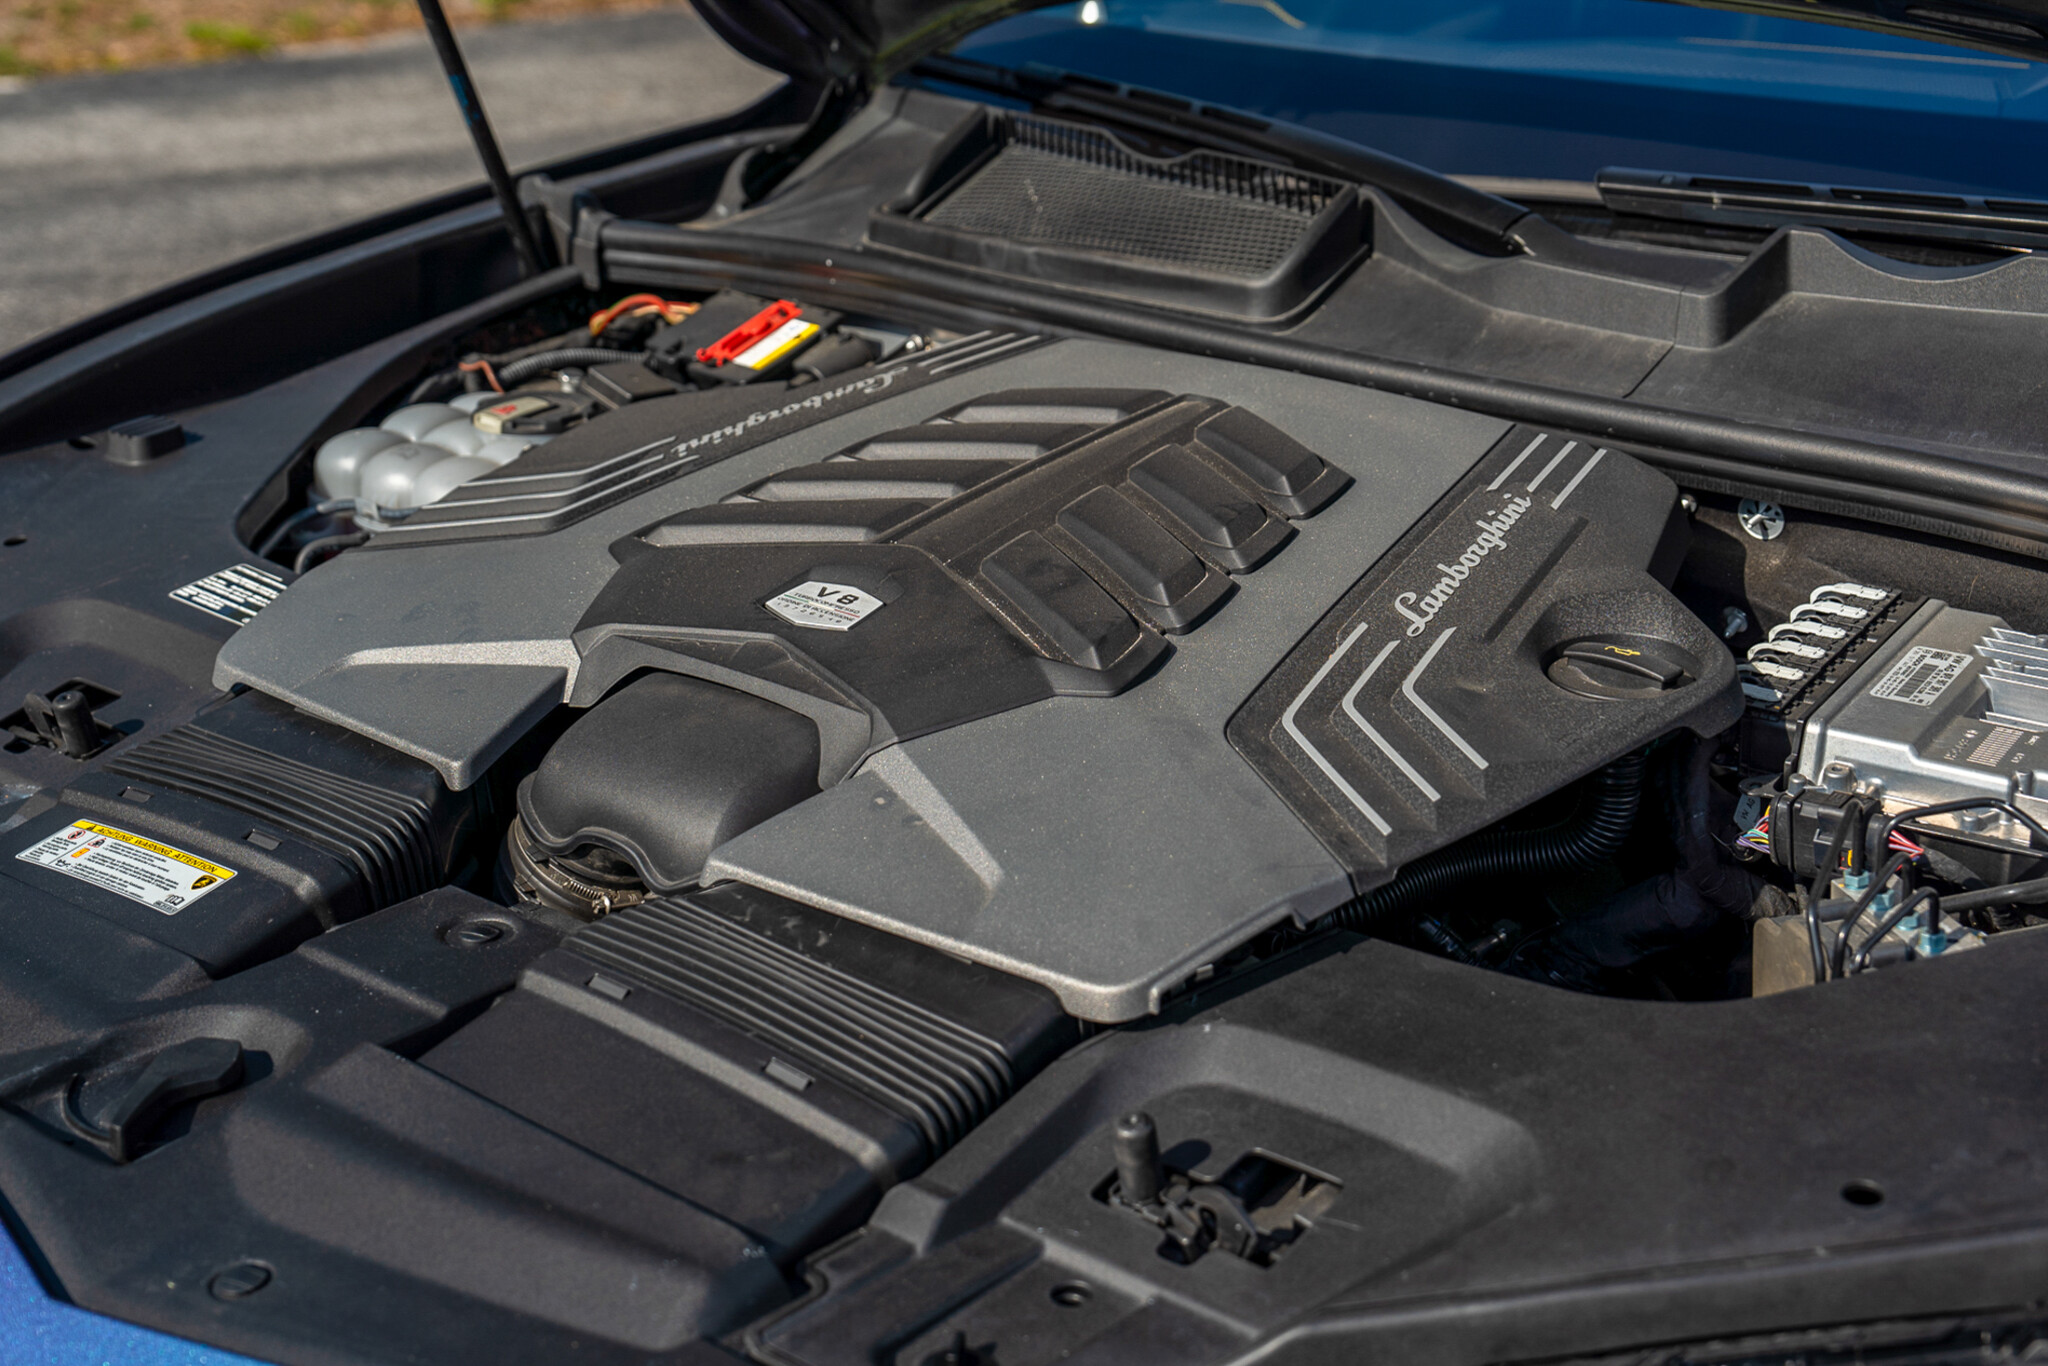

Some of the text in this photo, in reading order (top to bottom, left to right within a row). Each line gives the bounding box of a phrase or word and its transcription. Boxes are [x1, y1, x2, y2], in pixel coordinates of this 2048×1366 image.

[671, 366, 908, 457] Lamborghini
[817, 586, 860, 605] V8
[1394, 493, 1532, 637] Lamborghini
[97, 826, 134, 841] ACHTUNG
[134, 839, 173, 856] WARNING
[173, 853, 218, 873] ATTENTION
